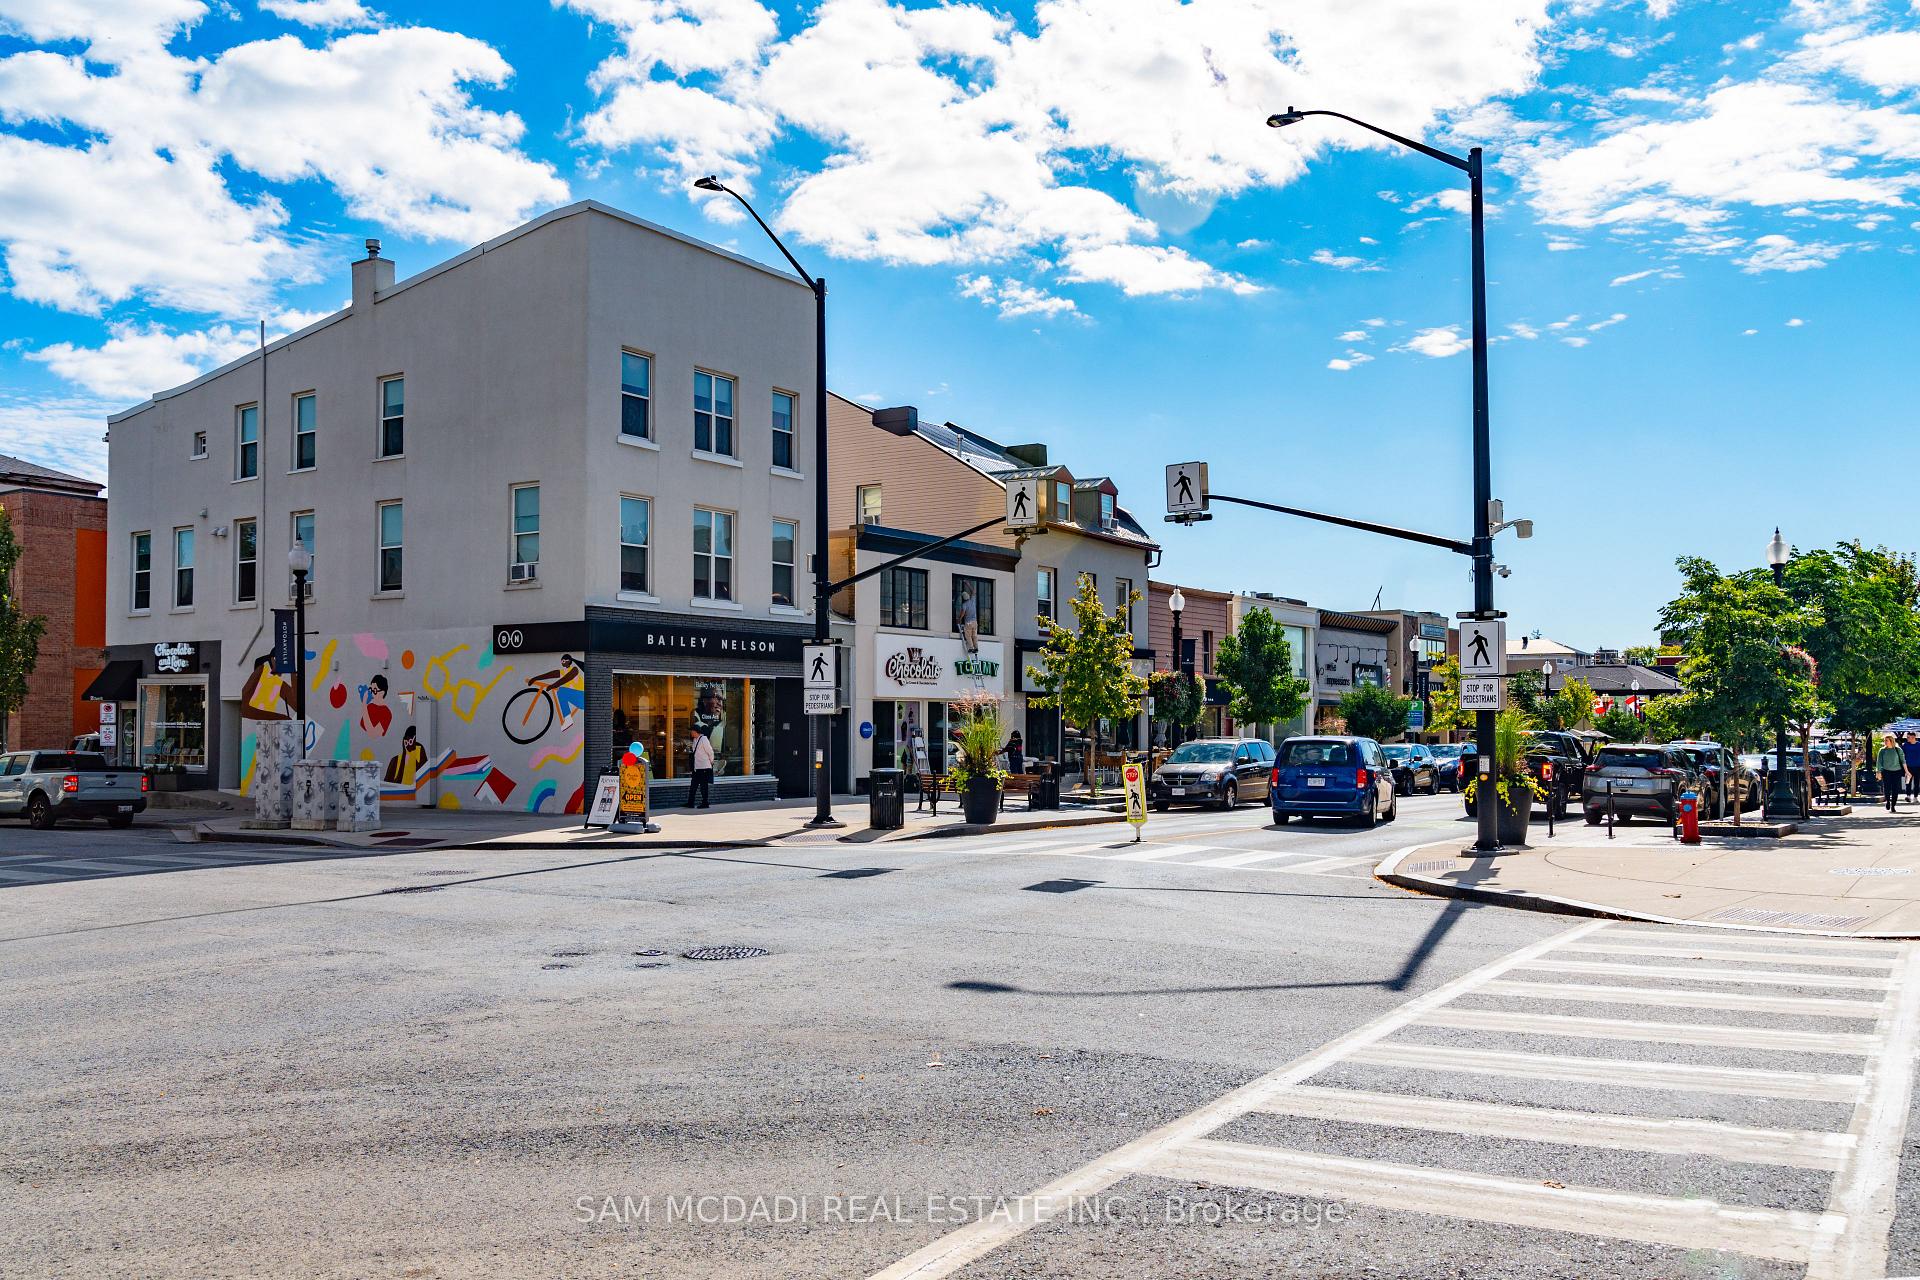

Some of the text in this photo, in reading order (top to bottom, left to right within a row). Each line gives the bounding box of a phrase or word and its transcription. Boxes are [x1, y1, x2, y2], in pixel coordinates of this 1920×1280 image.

[647, 634, 775, 652] BAILEY NELSON
[1466, 683, 1494, 692] STOP FOR
[1463, 694, 1497, 703] PEDESTRIANS
